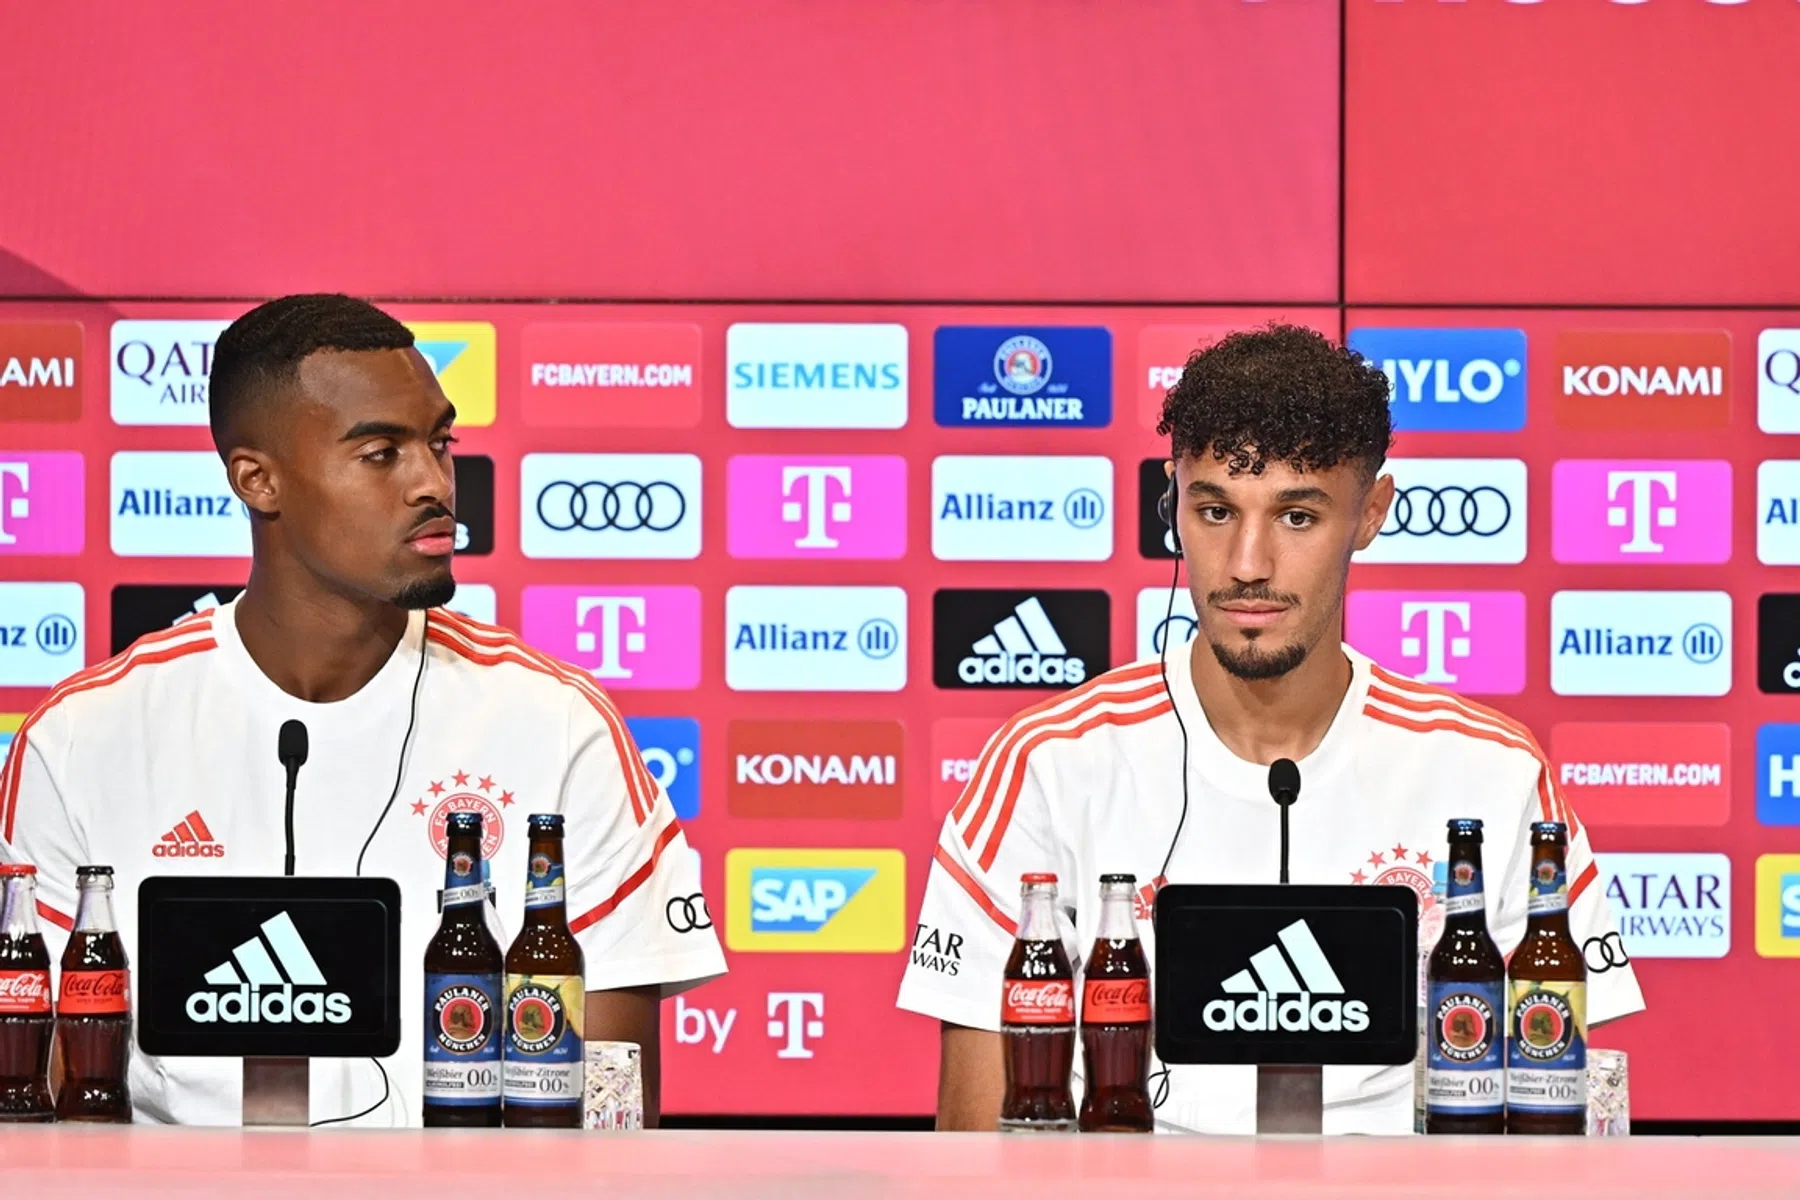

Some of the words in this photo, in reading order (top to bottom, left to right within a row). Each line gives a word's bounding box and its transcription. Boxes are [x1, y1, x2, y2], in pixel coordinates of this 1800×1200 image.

[0, 357, 74, 387] AMI
[117, 340, 215, 385] QAT
[531, 364, 692, 387] FCBAYERN.COM
[734, 362, 900, 389] SIEMENS
[1563, 365, 1722, 396] KONAMI
[962, 397, 1083, 420] PAULANER
[118, 489, 231, 517] Allianz
[940, 493, 1053, 522] Allianz
[734, 624, 848, 651] Allianz
[1559, 628, 1672, 656] Allianz
[958, 653, 1085, 684] adidas
[736, 754, 896, 785] KONAMI
[1560, 763, 1721, 786] FCBAYERN.COM
[447, 798, 497, 823] BAYERN
[152, 840, 225, 858] adidas
[1386, 872, 1431, 899] BAYERN
[1606, 874, 1722, 909] ATAR
[752, 879, 847, 923] SAP
[1620, 916, 1724, 936] IRWAYS
[913, 924, 964, 960] TAR
[911, 951, 960, 976] WAYS
[64, 973, 124, 997] Coca-Cola
[1008, 982, 1069, 1007] Coca-Cola
[185, 983, 352, 1024] adidas
[434, 987, 491, 1012] PAULANER
[509, 987, 561, 1013] PAULANER
[1203, 990, 1370, 1032] adidas
[1436, 995, 1491, 1020] PAULANER
[1516, 994, 1569, 1018] PAULANER
[674, 997, 736, 1053] by
[438, 1033, 486, 1051] MÜNCHEN
[511, 1034, 556, 1051] MÜNCHEN
[1440, 1041, 1487, 1060] MÜNCHEN
[1519, 1040, 1565, 1059] MÜNCHEN
